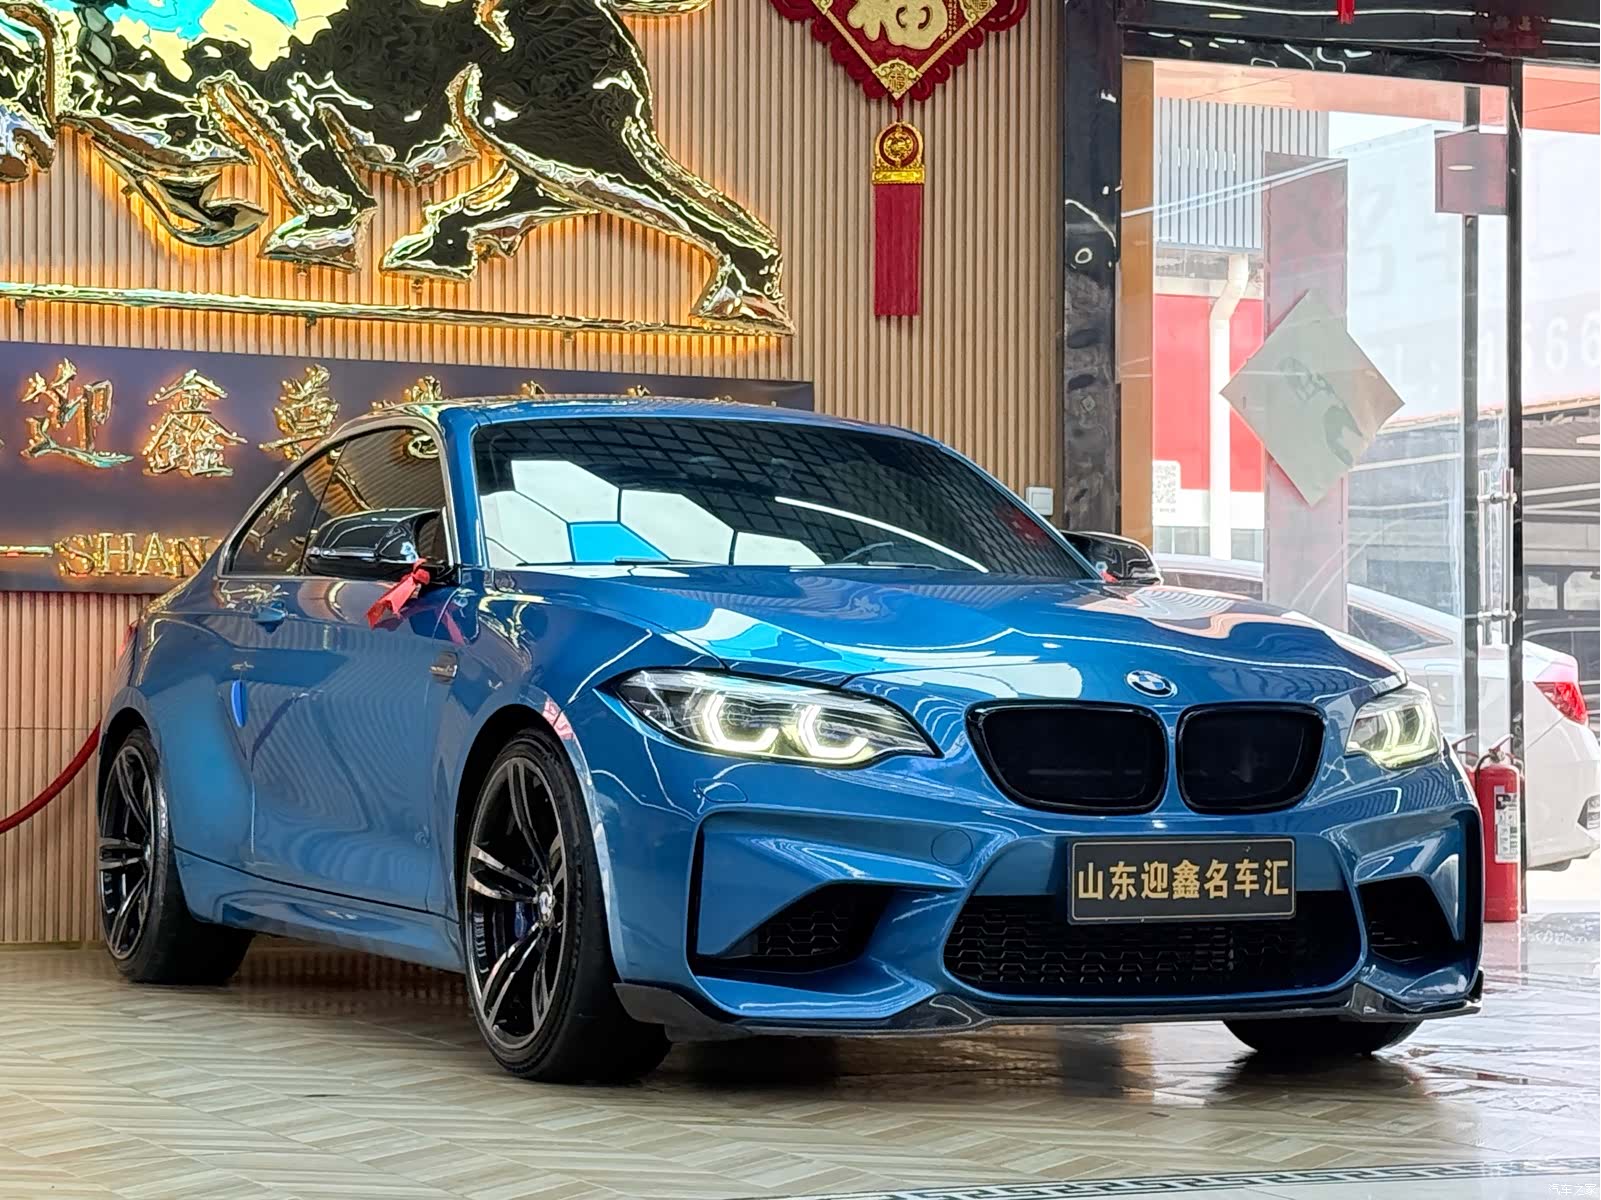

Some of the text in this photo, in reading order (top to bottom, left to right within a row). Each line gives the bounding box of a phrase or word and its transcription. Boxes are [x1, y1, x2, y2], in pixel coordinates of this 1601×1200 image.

[54, 532, 222, 578] SHAN
[1077, 859, 1289, 900] 山东迎鑫名车汇
